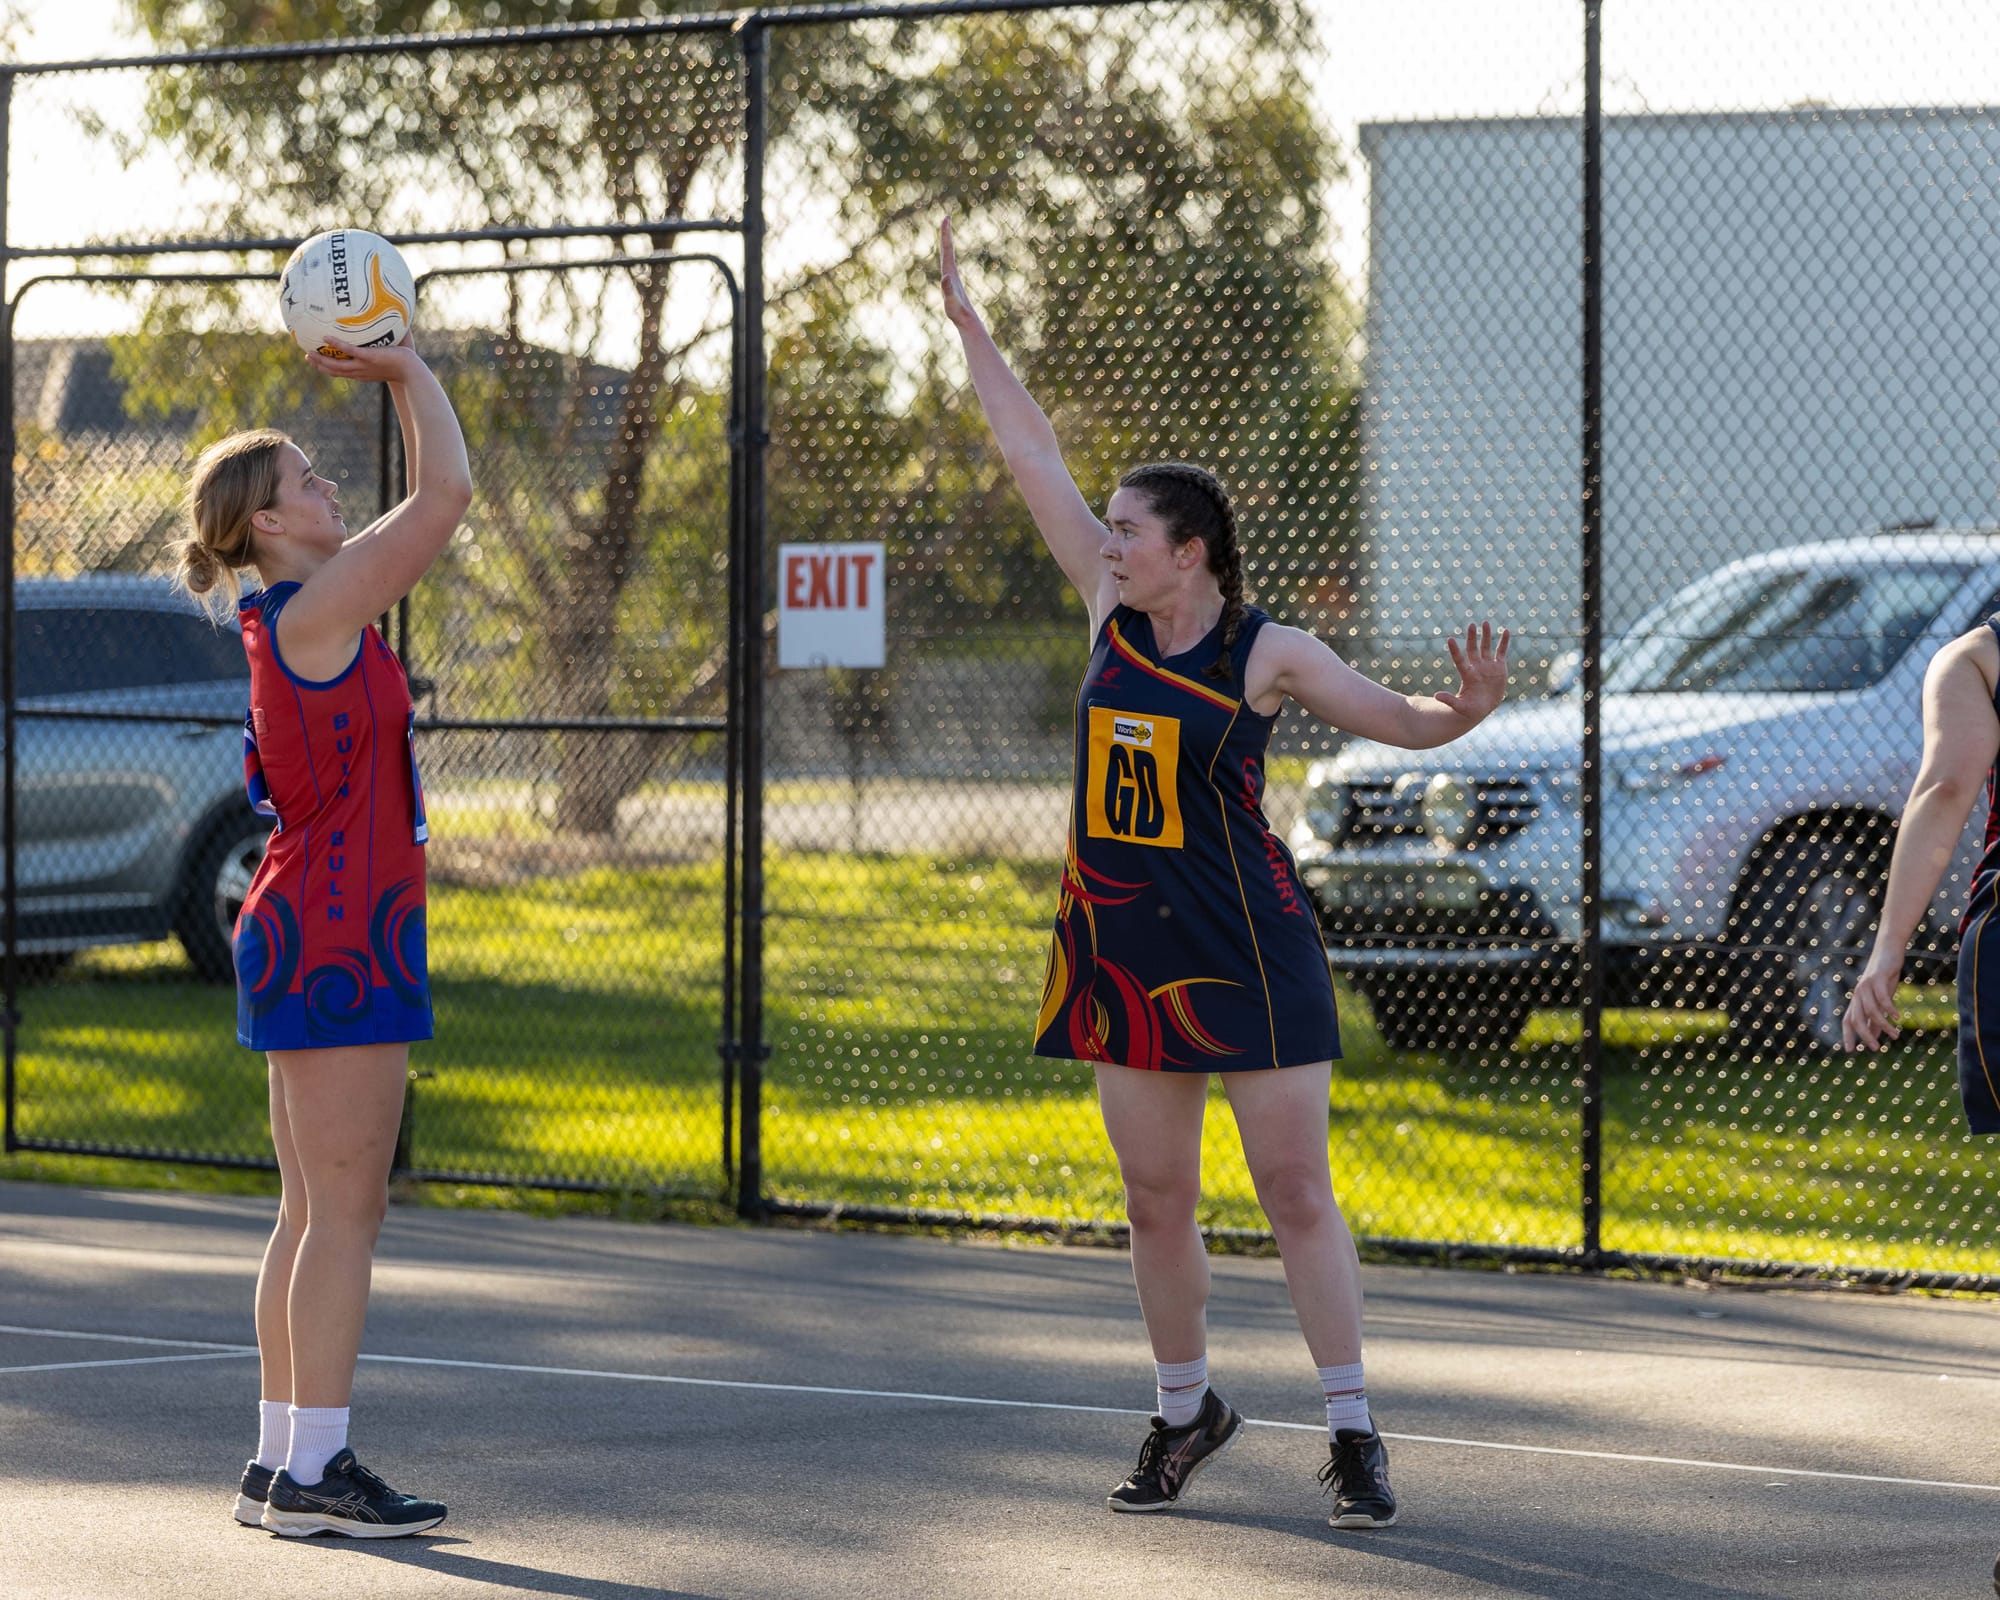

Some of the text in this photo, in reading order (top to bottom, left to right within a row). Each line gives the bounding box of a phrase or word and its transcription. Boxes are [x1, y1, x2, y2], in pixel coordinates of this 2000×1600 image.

[331, 232, 351, 307] ILBERT
[787, 555, 875, 609] EXIT
[1104, 743, 1165, 839] GD
[329, 831, 344, 920] BULN
